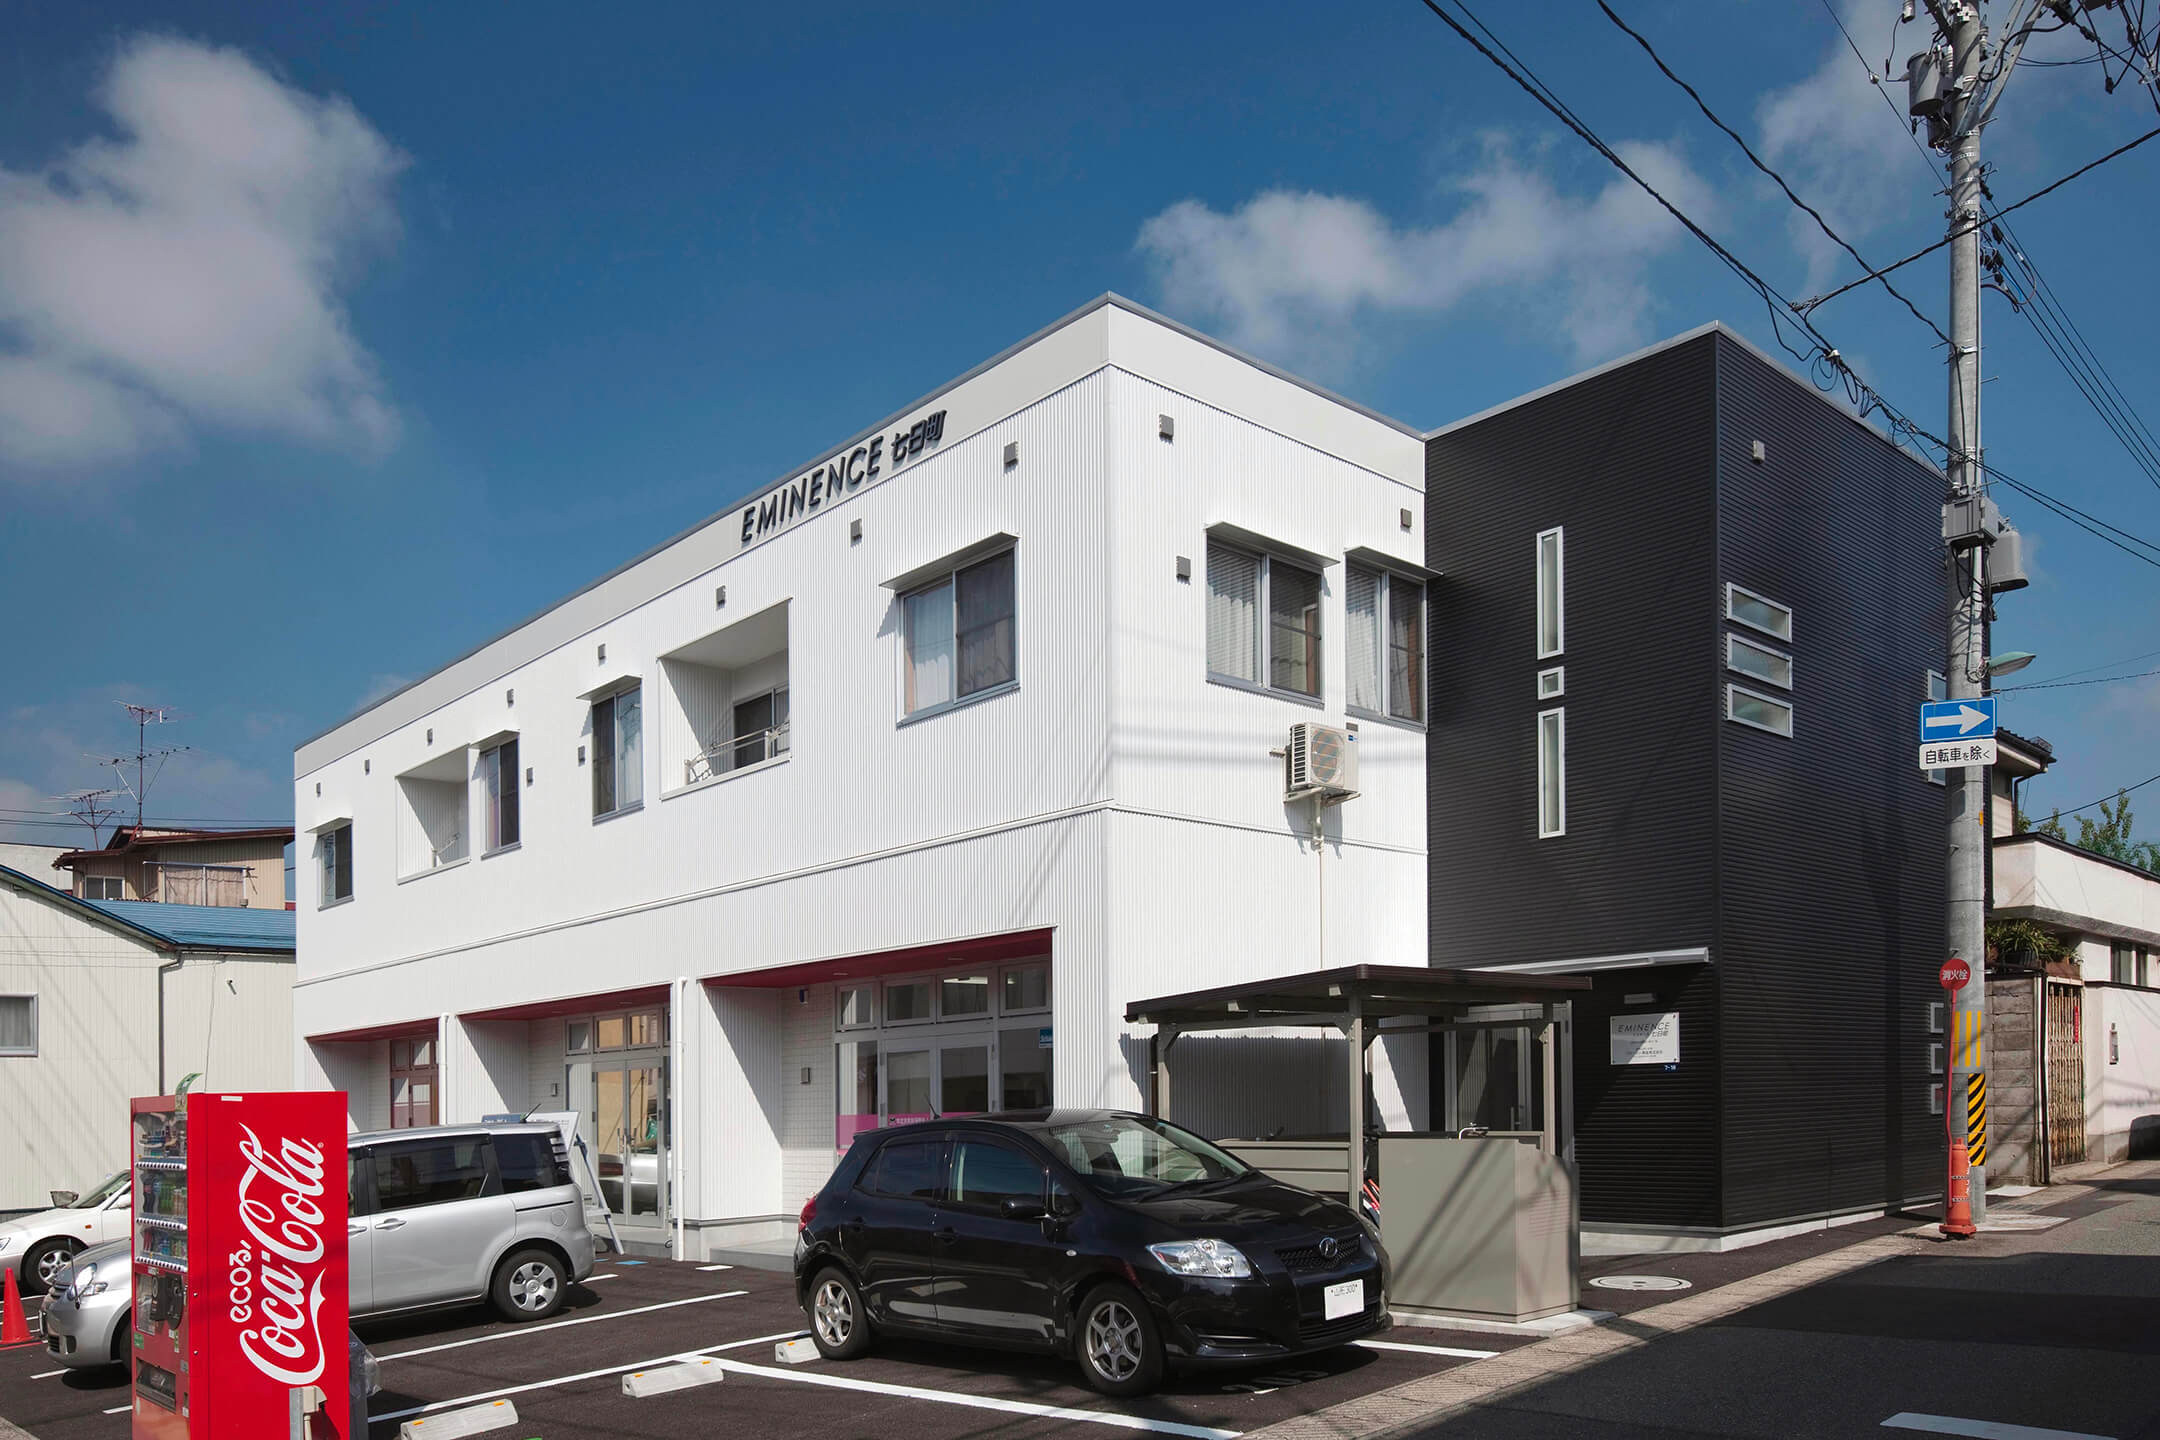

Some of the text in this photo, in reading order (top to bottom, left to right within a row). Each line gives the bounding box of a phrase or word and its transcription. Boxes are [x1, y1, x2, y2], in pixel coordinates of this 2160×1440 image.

[741, 409, 947, 542] EMINENCE 七日町
[1925, 745, 1991, 764] 自転車を除く
[1617, 1022, 1670, 1033] EMINENCE
